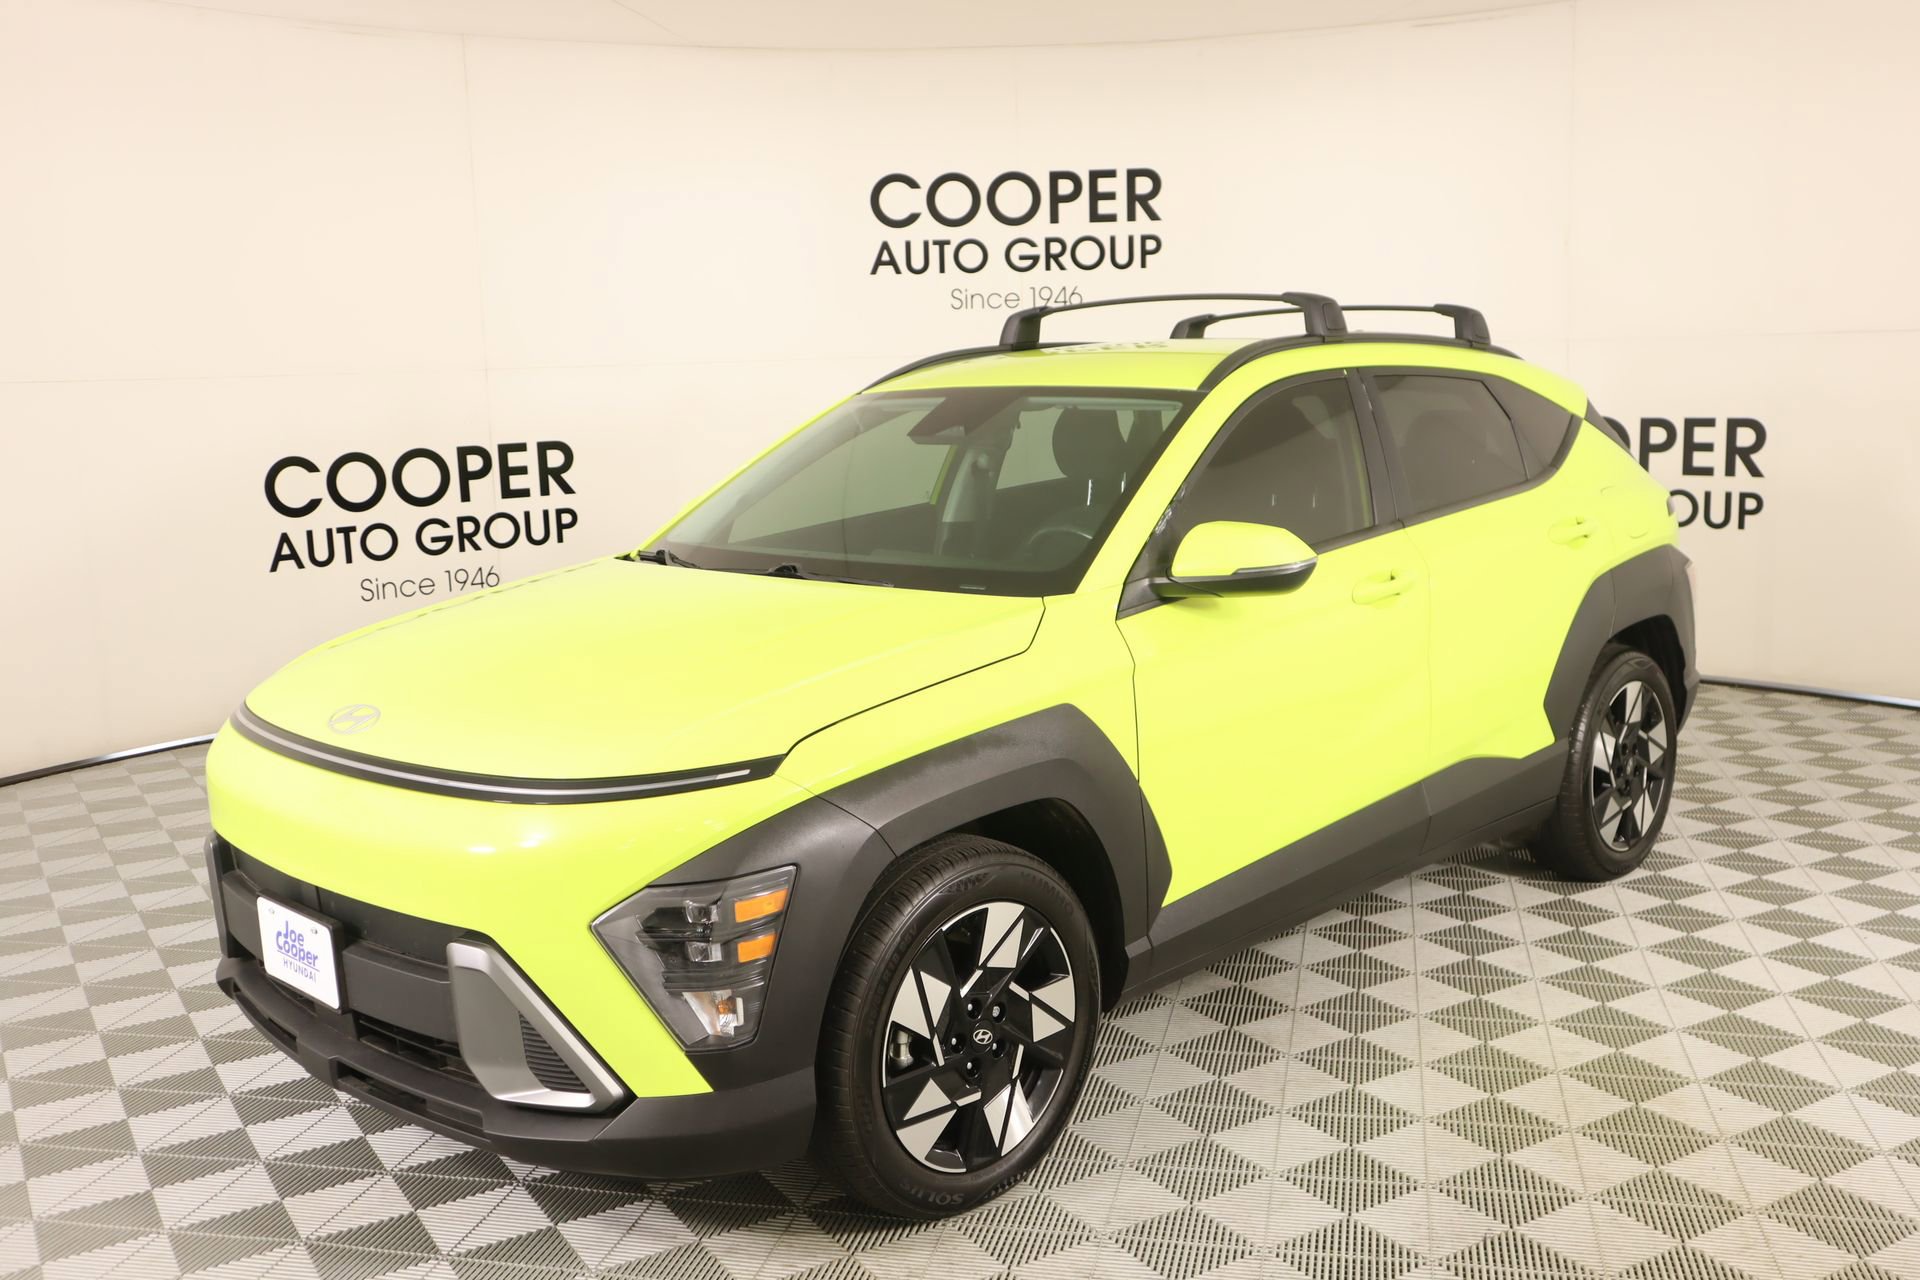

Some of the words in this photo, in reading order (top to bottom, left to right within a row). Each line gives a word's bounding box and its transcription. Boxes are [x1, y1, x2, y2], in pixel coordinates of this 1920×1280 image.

[870, 168, 1162, 229] COOPER
[870, 238, 989, 275] AUTO
[1004, 234, 1162, 273] GROUP
[950, 287, 1020, 310] Since
[1030, 285, 1083, 308] 1946
[1603, 416, 1767, 478] PER
[264, 440, 577, 518] COOPER
[1669, 489, 1764, 530] OUP
[269, 522, 399, 573] AUTO
[415, 507, 578, 556] GROUP
[360, 577, 436, 602] Since
[444, 565, 500, 592] 1946
[276, 930, 318, 967] Cooper
[283, 920, 305, 947] Joe
[283, 957, 317, 984] HYUNDAI
